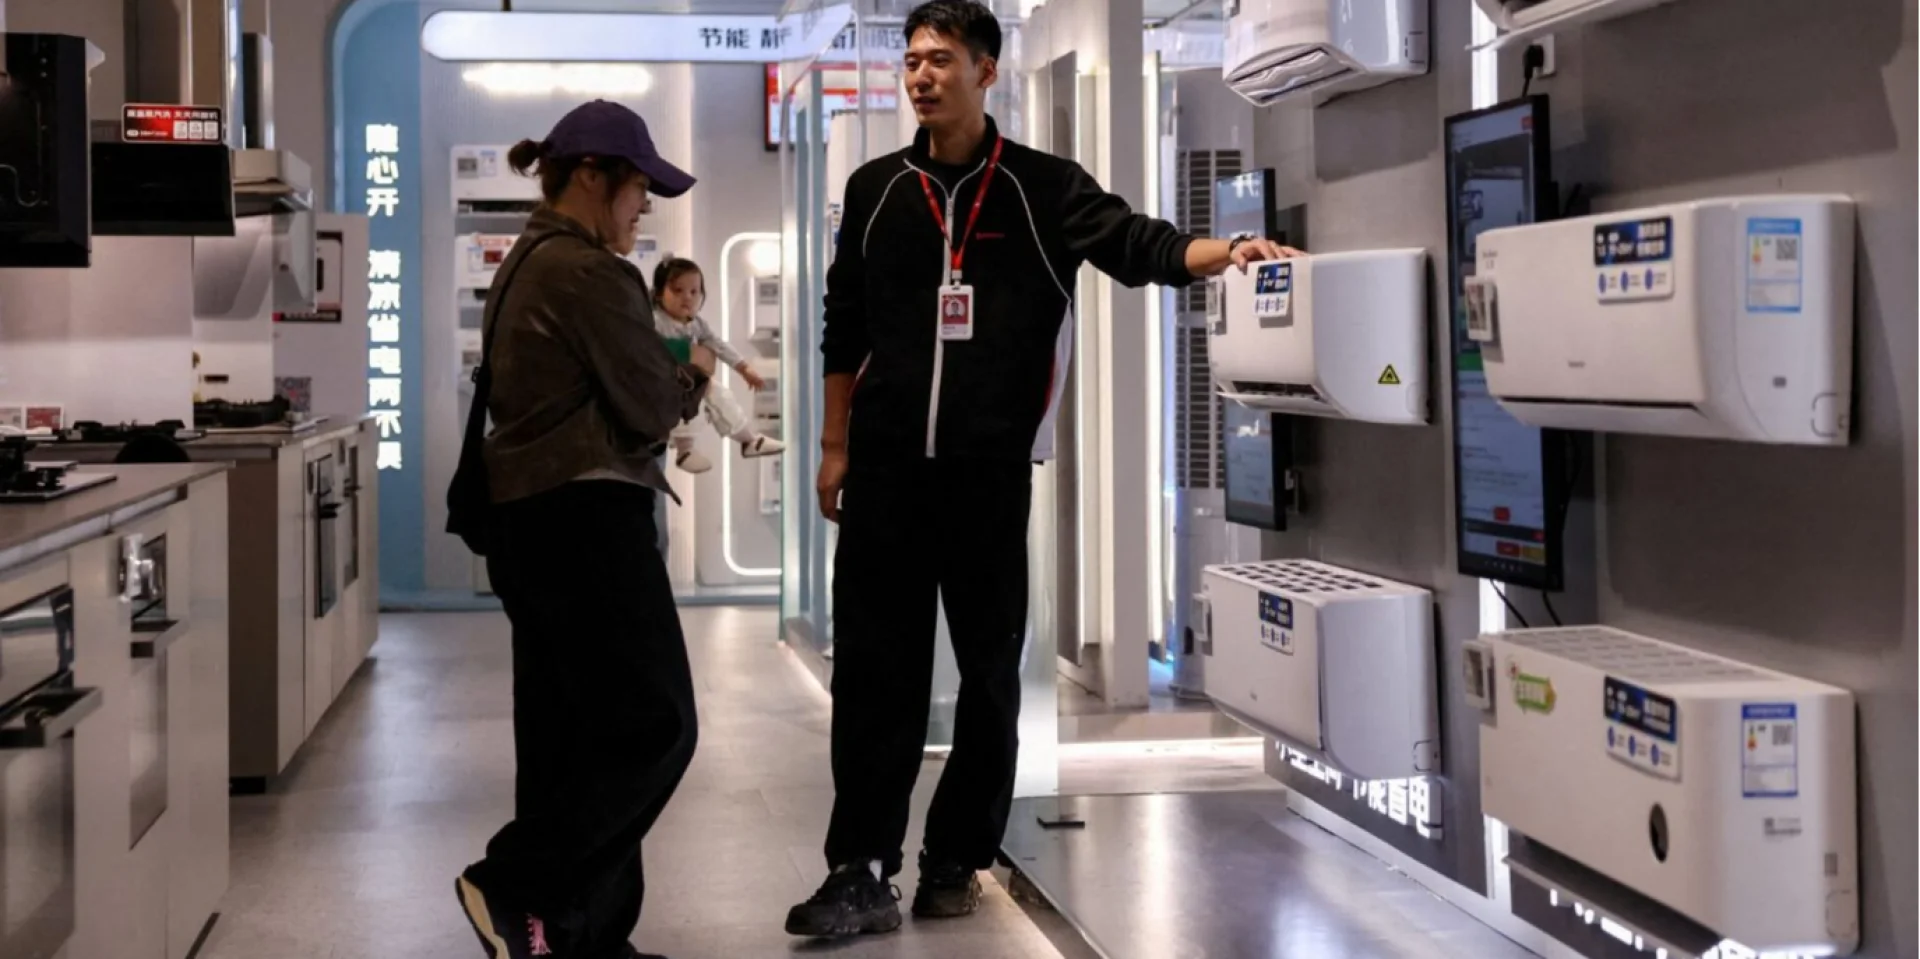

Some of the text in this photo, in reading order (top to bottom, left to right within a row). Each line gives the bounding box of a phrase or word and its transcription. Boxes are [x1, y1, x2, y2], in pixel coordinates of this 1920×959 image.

[699, 28, 750, 49] 节能
[366, 124, 399, 217] 随心开
